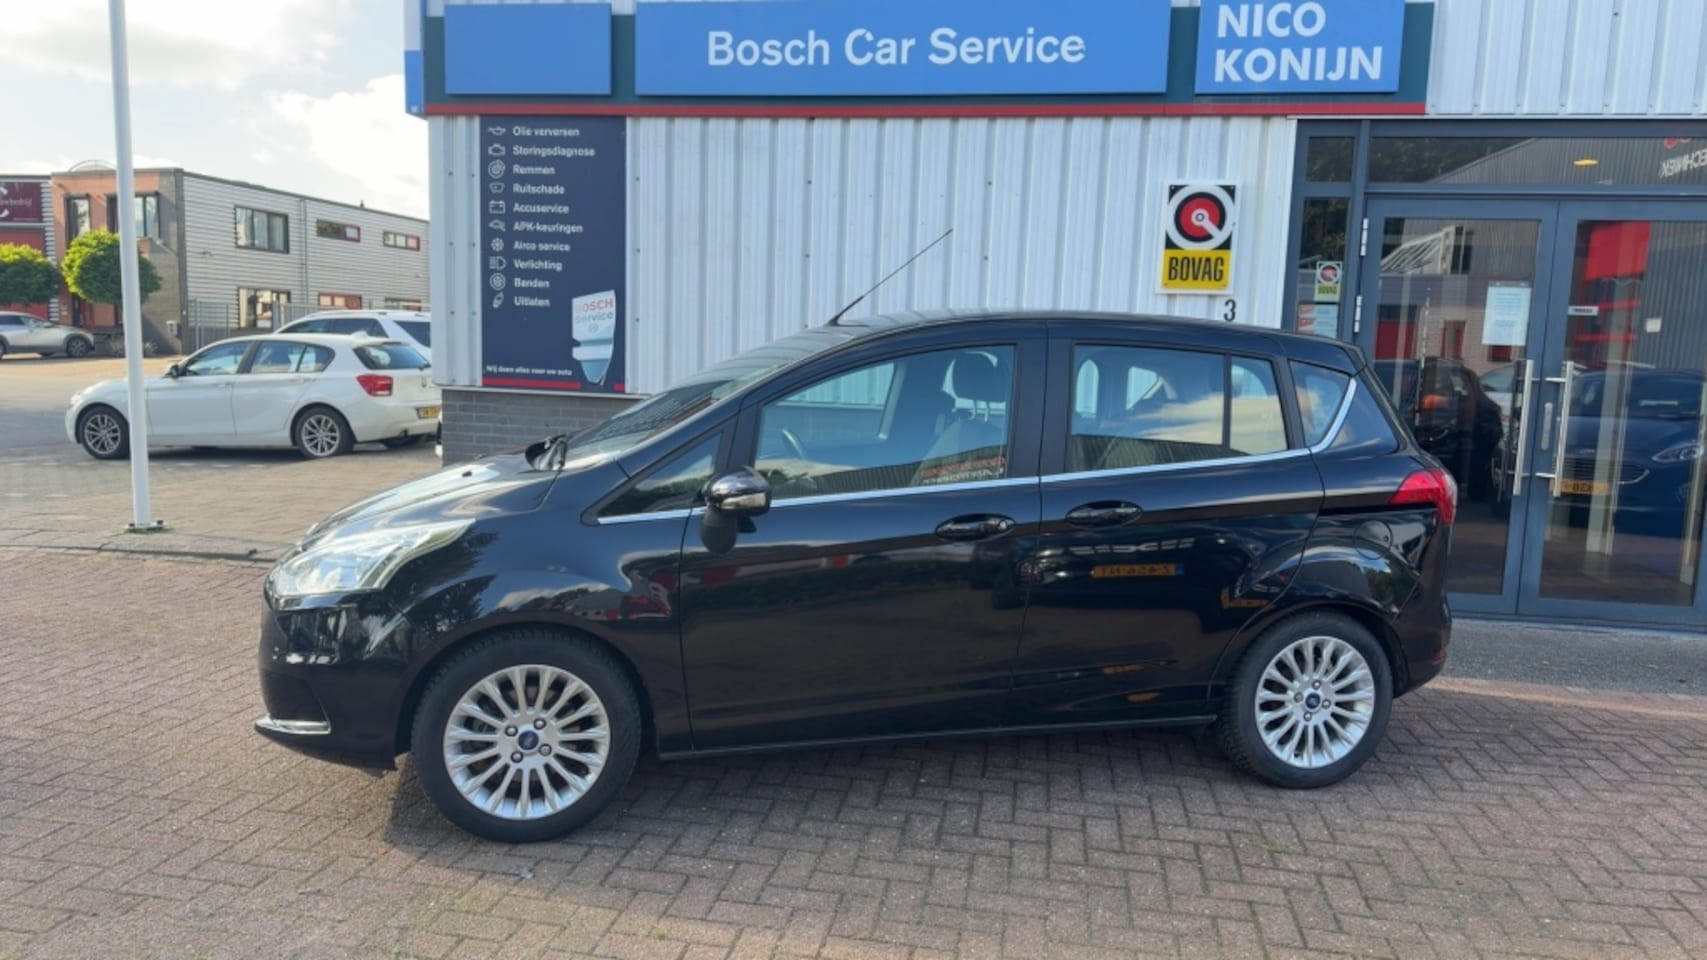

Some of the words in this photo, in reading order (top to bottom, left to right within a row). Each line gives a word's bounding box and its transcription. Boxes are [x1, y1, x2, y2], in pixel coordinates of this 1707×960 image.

[1217, 1, 1326, 38] NICO
[707, 29, 830, 66] Bosch
[844, 28, 916, 66] Car
[928, 26, 1086, 65] Service
[1214, 46, 1383, 83] KONIJN
[512, 126, 532, 136] Olie
[534, 127, 580, 137] verversen
[512, 145, 596, 158] Storingsdiagnose
[512, 164, 555, 175] Remmen
[512, 182, 566, 194] Ruitschade
[512, 202, 570, 214] Accuservice
[512, 221, 584, 235] APK-keuringen
[512, 240, 536, 251] Airco
[538, 242, 571, 252] service
[513, 259, 563, 272] Verlichting
[1168, 256, 1225, 282] BOVAG
[514, 277, 550, 289] Banden
[514, 296, 551, 307] Uitlaten
[1223, 299, 1237, 322] 3
